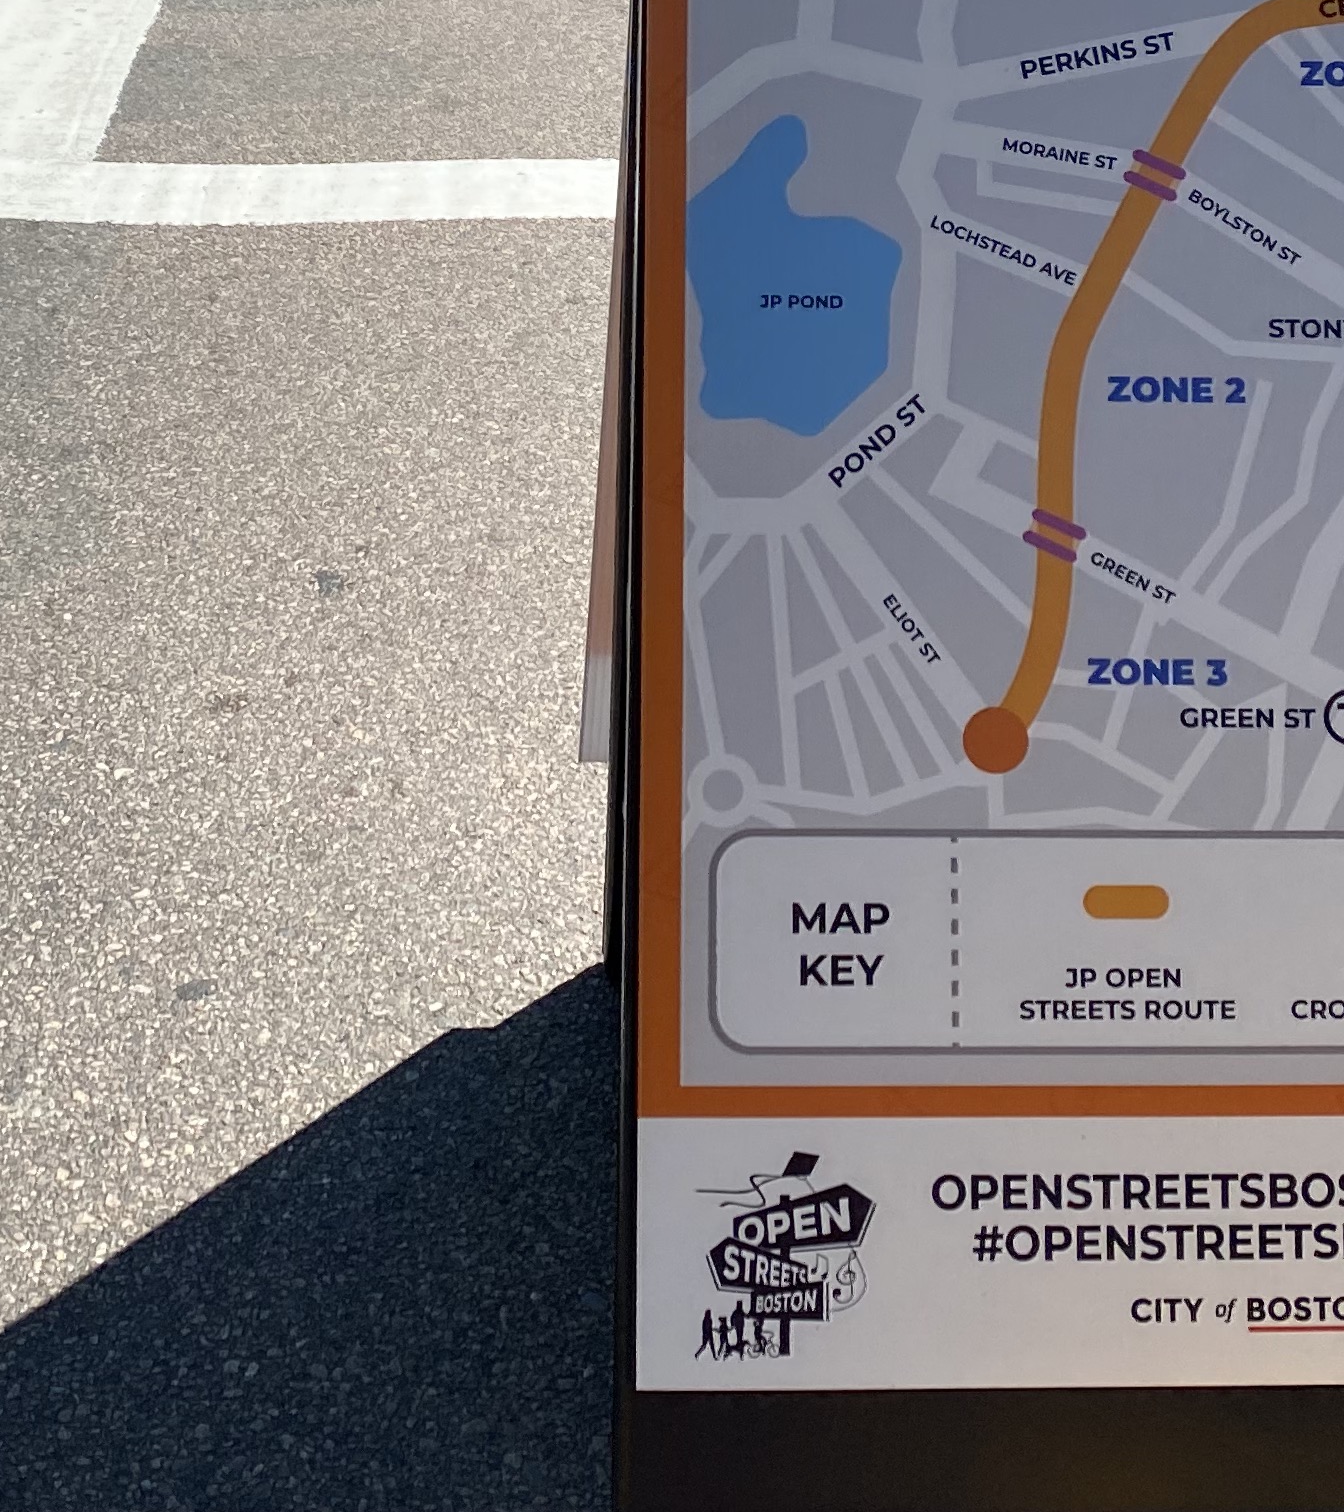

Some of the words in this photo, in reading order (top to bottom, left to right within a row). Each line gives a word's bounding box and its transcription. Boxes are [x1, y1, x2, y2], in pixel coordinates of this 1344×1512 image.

[1020, 40, 1137, 79] PERKINS
[1143, 31, 1175, 55] ST
[1002, 138, 1088, 167] MORAINE
[1093, 153, 1118, 170] ST
[1187, 189, 1277, 250] BOYLSTON
[1276, 244, 1302, 266] ST
[930, 215, 1037, 269] LOCHSTEAD
[1039, 262, 1078, 285] AVE
[759, 294, 782, 309] JP
[787, 294, 843, 309] POND
[1107, 376, 1213, 404] ZONE
[1219, 376, 1246, 403] 2
[827, 423, 898, 488] POND
[896, 393, 928, 426] ST
[1090, 551, 1152, 593] GREEN
[1153, 585, 1178, 605] ST
[882, 593, 924, 644] ELIOT
[919, 639, 942, 666] ST
[1087, 658, 1195, 686] ZONE
[1207, 658, 1228, 686] 3
[1180, 708, 1275, 729] GREEN
[1284, 707, 1316, 729] ST
[792, 902, 890, 934] MAP
[800, 955, 884, 986] KEY
[1065, 968, 1096, 988] JP
[1105, 968, 1182, 988] OPEN
[1019, 999, 1136, 1020] STREETS
[1144, 999, 1236, 1020] ROUTE
[736, 1196, 852, 1246] OPEN
[756, 1289, 818, 1313] BOSTON
[1130, 1298, 1203, 1324] CITY
[1215, 1298, 1238, 1324] of
